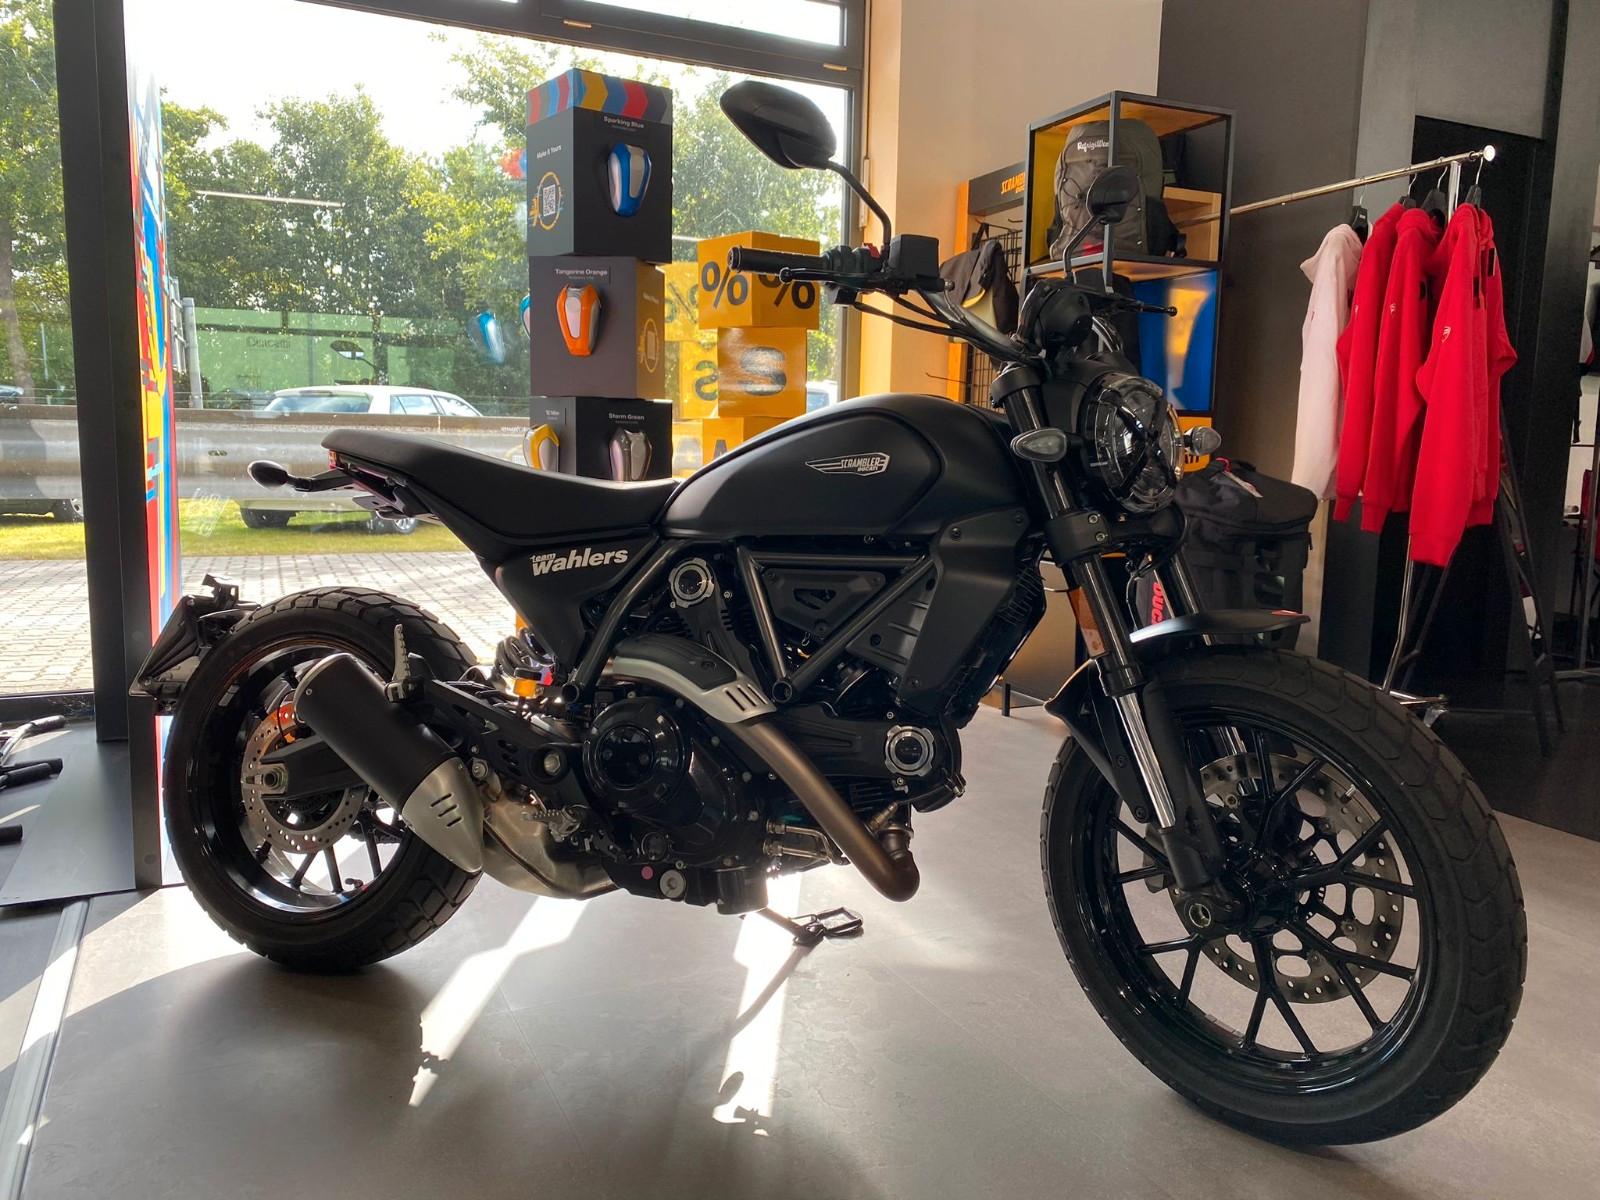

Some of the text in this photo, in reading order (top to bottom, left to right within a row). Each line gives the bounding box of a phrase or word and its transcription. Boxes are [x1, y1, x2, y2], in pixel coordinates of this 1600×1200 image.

[630, 120, 645, 129] Blue
[554, 268, 608, 277] Tangerine Orange
[701, 261, 749, 309] %
[737, 346, 787, 397] S
[627, 413, 645, 421] Green
[841, 457, 881, 469] SCRAMBLER
[529, 553, 556, 562] team
[1152, 582, 1164, 625] DUC
